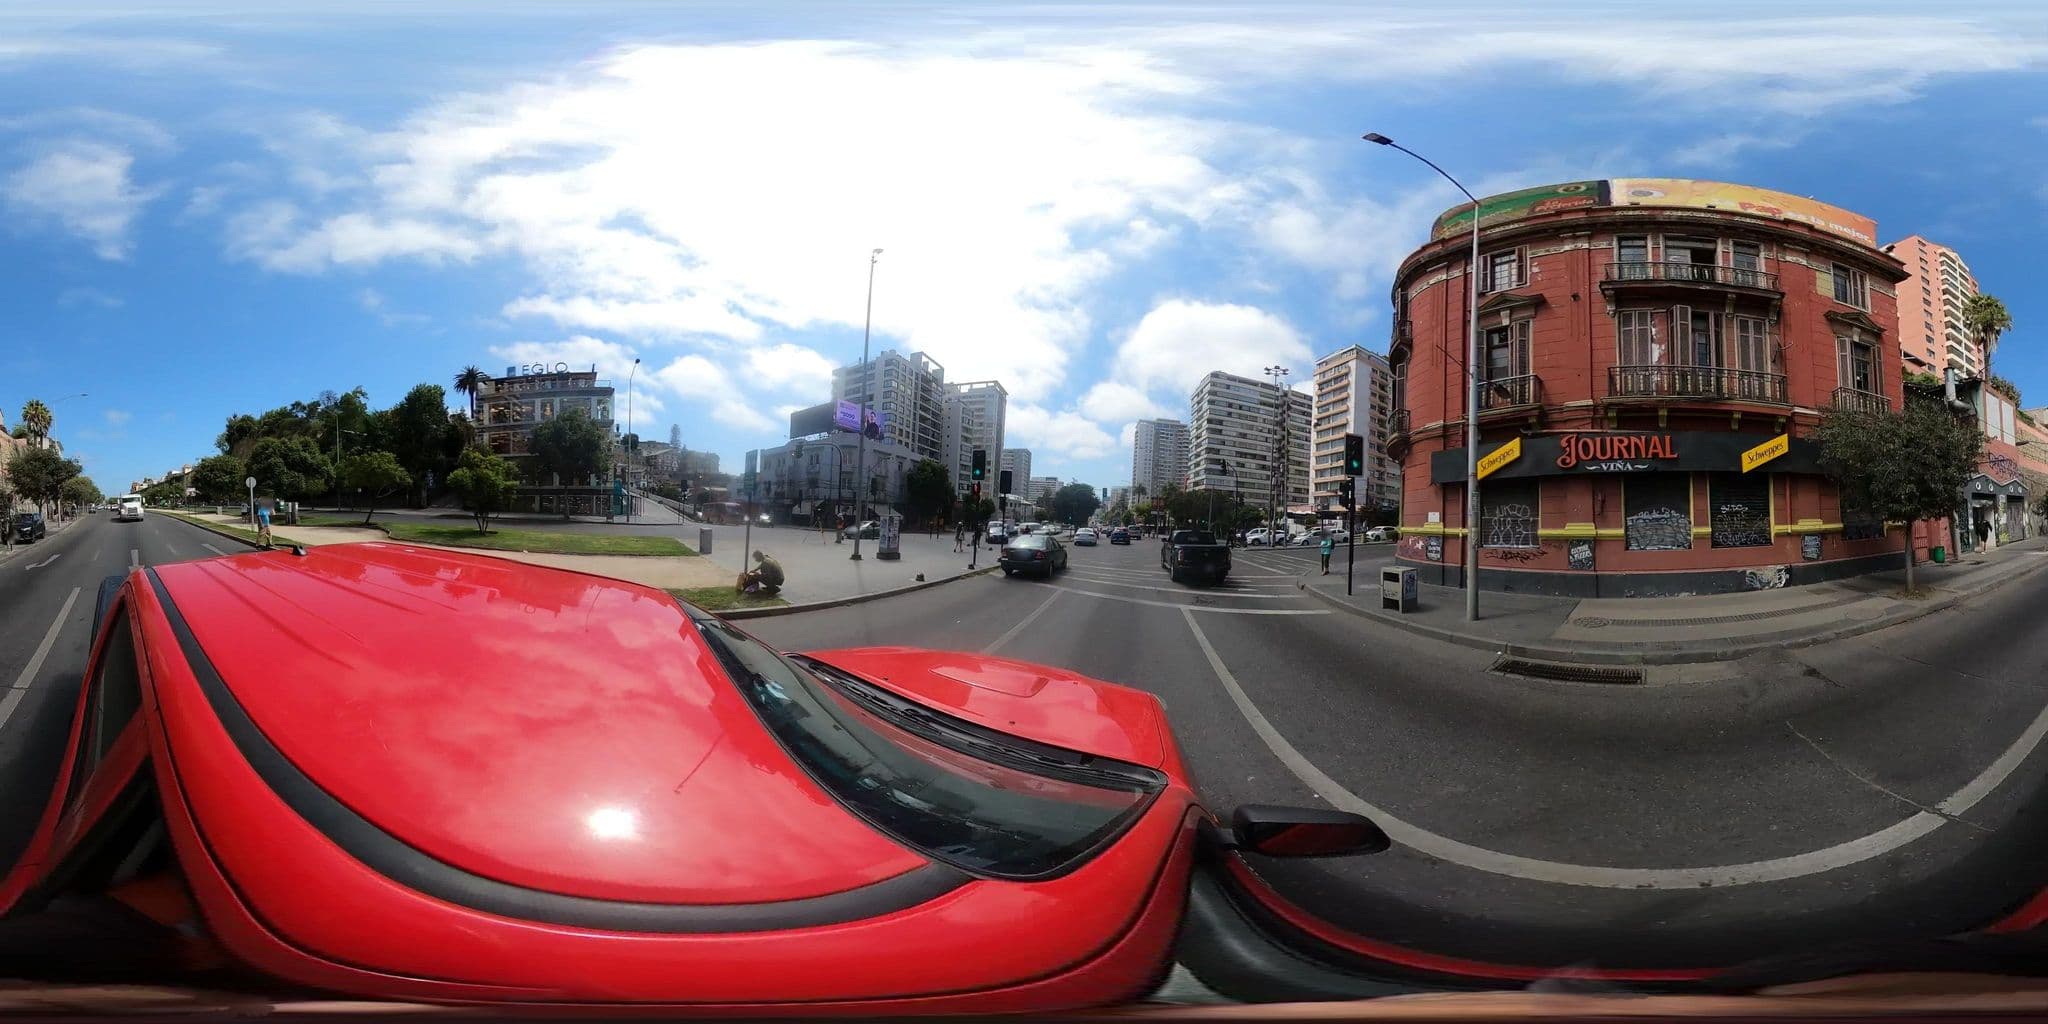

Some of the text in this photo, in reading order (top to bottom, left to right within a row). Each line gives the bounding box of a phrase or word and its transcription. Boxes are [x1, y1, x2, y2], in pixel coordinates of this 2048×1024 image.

[522, 362, 568, 376] EGLO
[1480, 448, 1514, 472] Schweppes
[1556, 433, 1679, 468] JOURNAL
[1747, 442, 1784, 464] Schweppes
[1600, 460, 1633, 471] VIÑA
